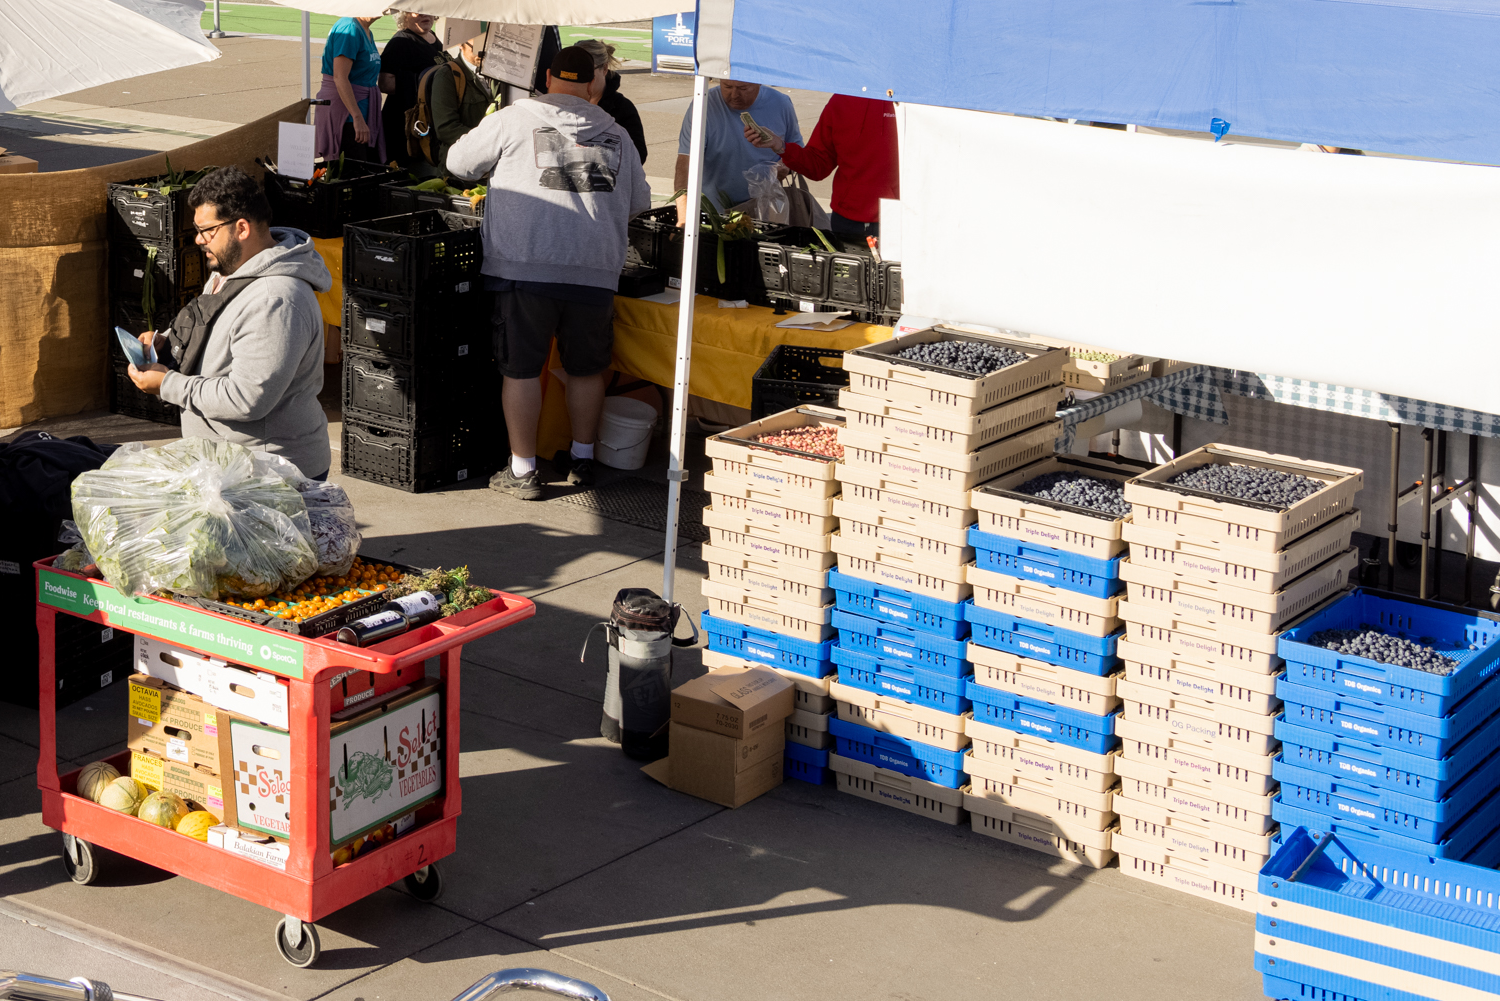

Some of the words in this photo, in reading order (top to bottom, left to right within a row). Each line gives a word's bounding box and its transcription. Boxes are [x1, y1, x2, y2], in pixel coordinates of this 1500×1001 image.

[668, 36, 690, 44] PORT
[902, 465, 920, 473] Delight
[902, 500, 919, 508] Delight
[752, 507, 764, 515] Triple
[765, 510, 781, 518] Delight
[1041, 531, 1059, 540] Delight
[750, 542, 762, 550] Triple
[897, 539, 915, 547] Delight
[1034, 568, 1055, 578] Organics
[1200, 564, 1220, 573] Delight
[881, 571, 894, 579] Triple
[895, 575, 913, 583] Delight
[44, 581, 77, 598] Foodwise
[761, 582, 778, 590] Delight
[889, 608, 908, 619] Organics
[1020, 604, 1034, 612] Triple
[1036, 608, 1054, 617] Delight
[1178, 601, 1193, 609] Triple
[1195, 605, 1215, 614] Delight
[83, 594, 104, 609] Keep
[106, 600, 126, 615] local
[127, 608, 177, 630] restaurants
[179, 621, 187, 633] &
[188, 623, 215, 641] farms
[217, 632, 254, 656] thriving
[1030, 644, 1050, 654] Organics
[1180, 639, 1194, 647] Triple
[1196, 643, 1216, 652] Delight
[272, 651, 297, 665] SpotOn
[757, 649, 775, 659] Organics
[893, 648, 913, 658] Organics
[132, 685, 159, 698] OCTAVIA
[730, 686, 752, 699] GLASS
[891, 684, 911, 695] Organics
[1037, 687, 1055, 696] Delight
[1176, 679, 1191, 688] Triple
[1193, 684, 1214, 694] Delight
[1357, 683, 1382, 694] Organics
[345, 688, 374, 706] PRODUCE
[132, 700, 158, 710] AVOCADOS
[132, 710, 147, 718] SMALL
[170, 717, 202, 732] PRODUCE
[1031, 722, 1052, 732] Organics
[1172, 720, 1183, 729] OG
[1186, 723, 1216, 738] Packing
[1353, 724, 1378, 735] Organics
[398, 710, 437, 768] Select
[134, 753, 162, 767] FRANCES
[889, 757, 908, 767] Organics
[1019, 757, 1033, 765] Triple
[1035, 761, 1054, 771] Delight
[1174, 758, 1189, 766] Triple
[1191, 762, 1210, 772] Delight
[135, 768, 160, 780] AVOCADOS
[141, 764, 154, 772] HASS
[1352, 765, 1376, 777] Organics
[258, 771, 290, 798] Selec
[398, 765, 437, 798] VEGETABLES
[174, 788, 206, 804] PRODUCE
[879, 790, 892, 798] Triple
[893, 794, 910, 804] Delight
[1173, 797, 1188, 805] Triple
[1190, 801, 1210, 812] Delight
[1351, 807, 1375, 819] Organics
[253, 813, 290, 832] VEGETAB
[1018, 832, 1032, 840] Triple
[1033, 836, 1052, 846] Delight
[1172, 838, 1187, 847] Triple
[1189, 843, 1209, 853] Delight
[234, 841, 264, 857] Balakian
[266, 851, 286, 863] Farms
[417, 843, 427, 866] 2
[1175, 877, 1189, 885] Triple
